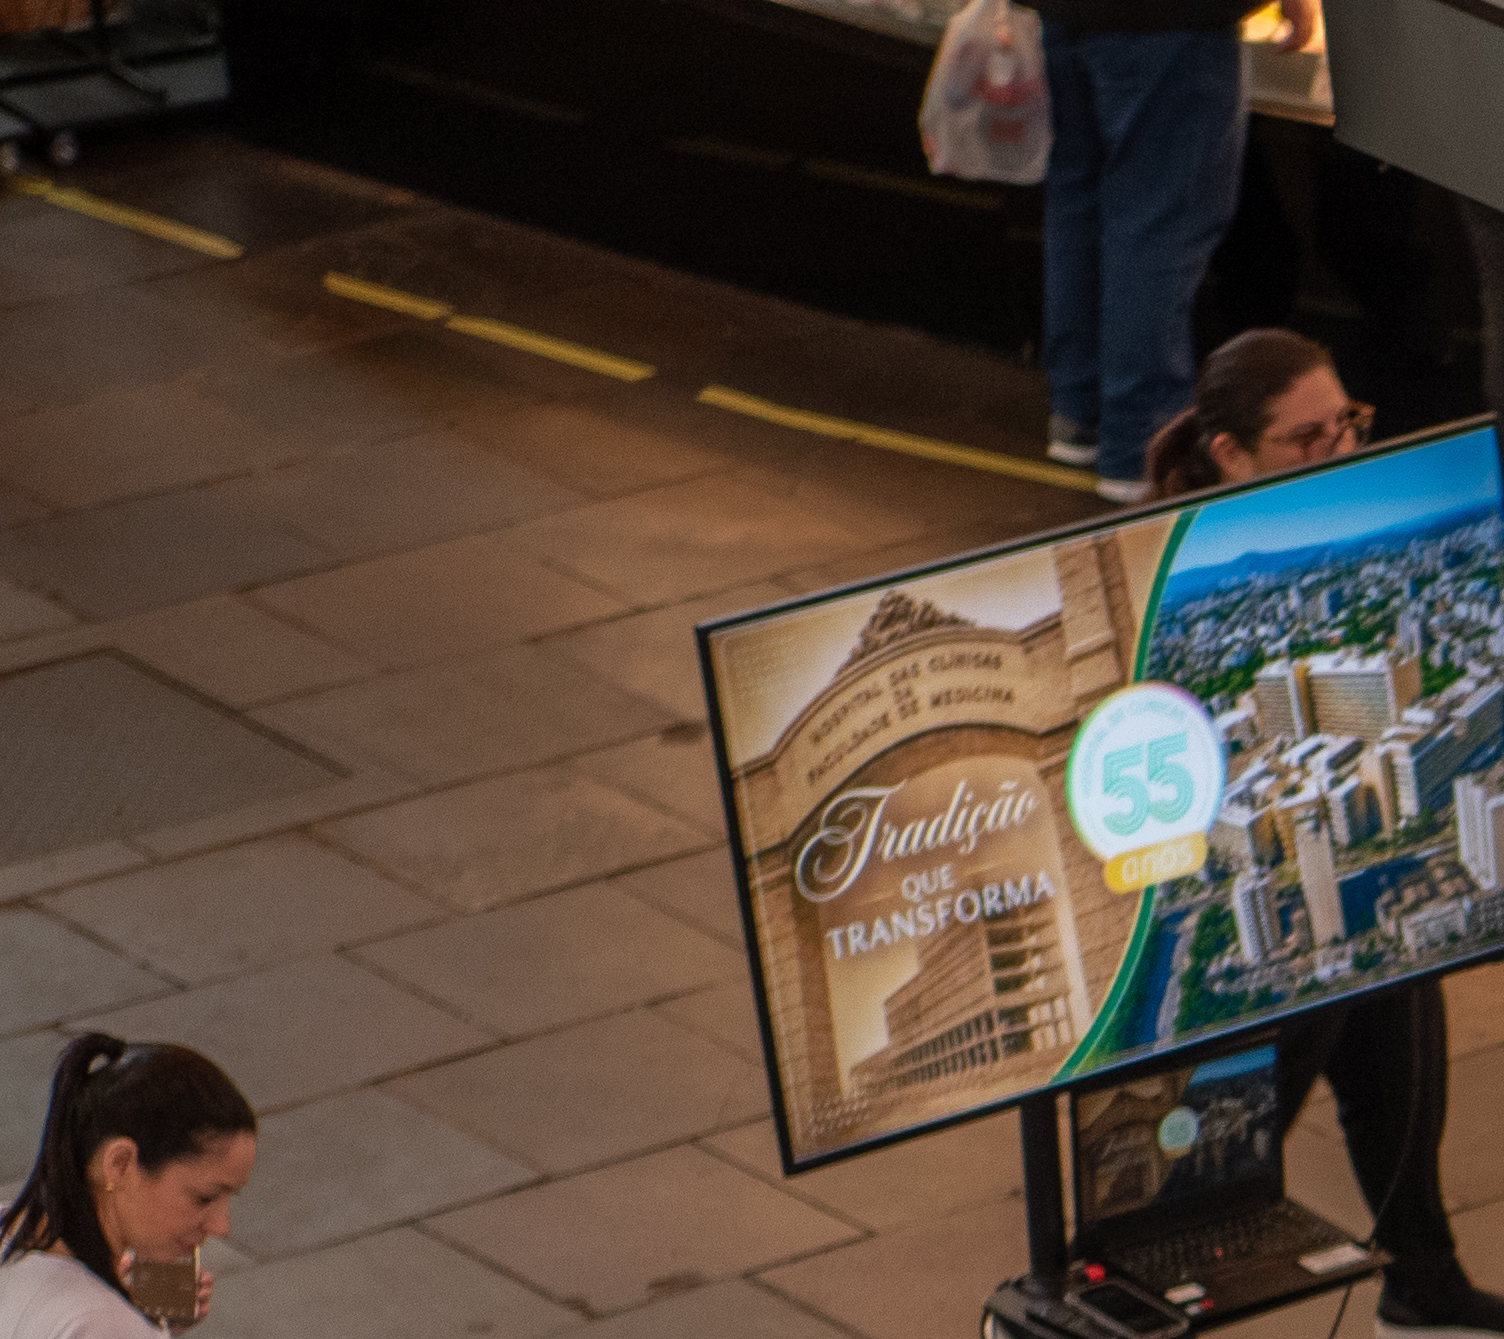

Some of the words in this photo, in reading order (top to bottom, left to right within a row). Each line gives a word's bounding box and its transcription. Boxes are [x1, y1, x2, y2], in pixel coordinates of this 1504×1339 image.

[1102, 731, 1195, 837] 55
[796, 779, 1042, 903] Tradição
[901, 863, 956, 903] QUE
[826, 869, 1056, 960] TRANSFORMA
